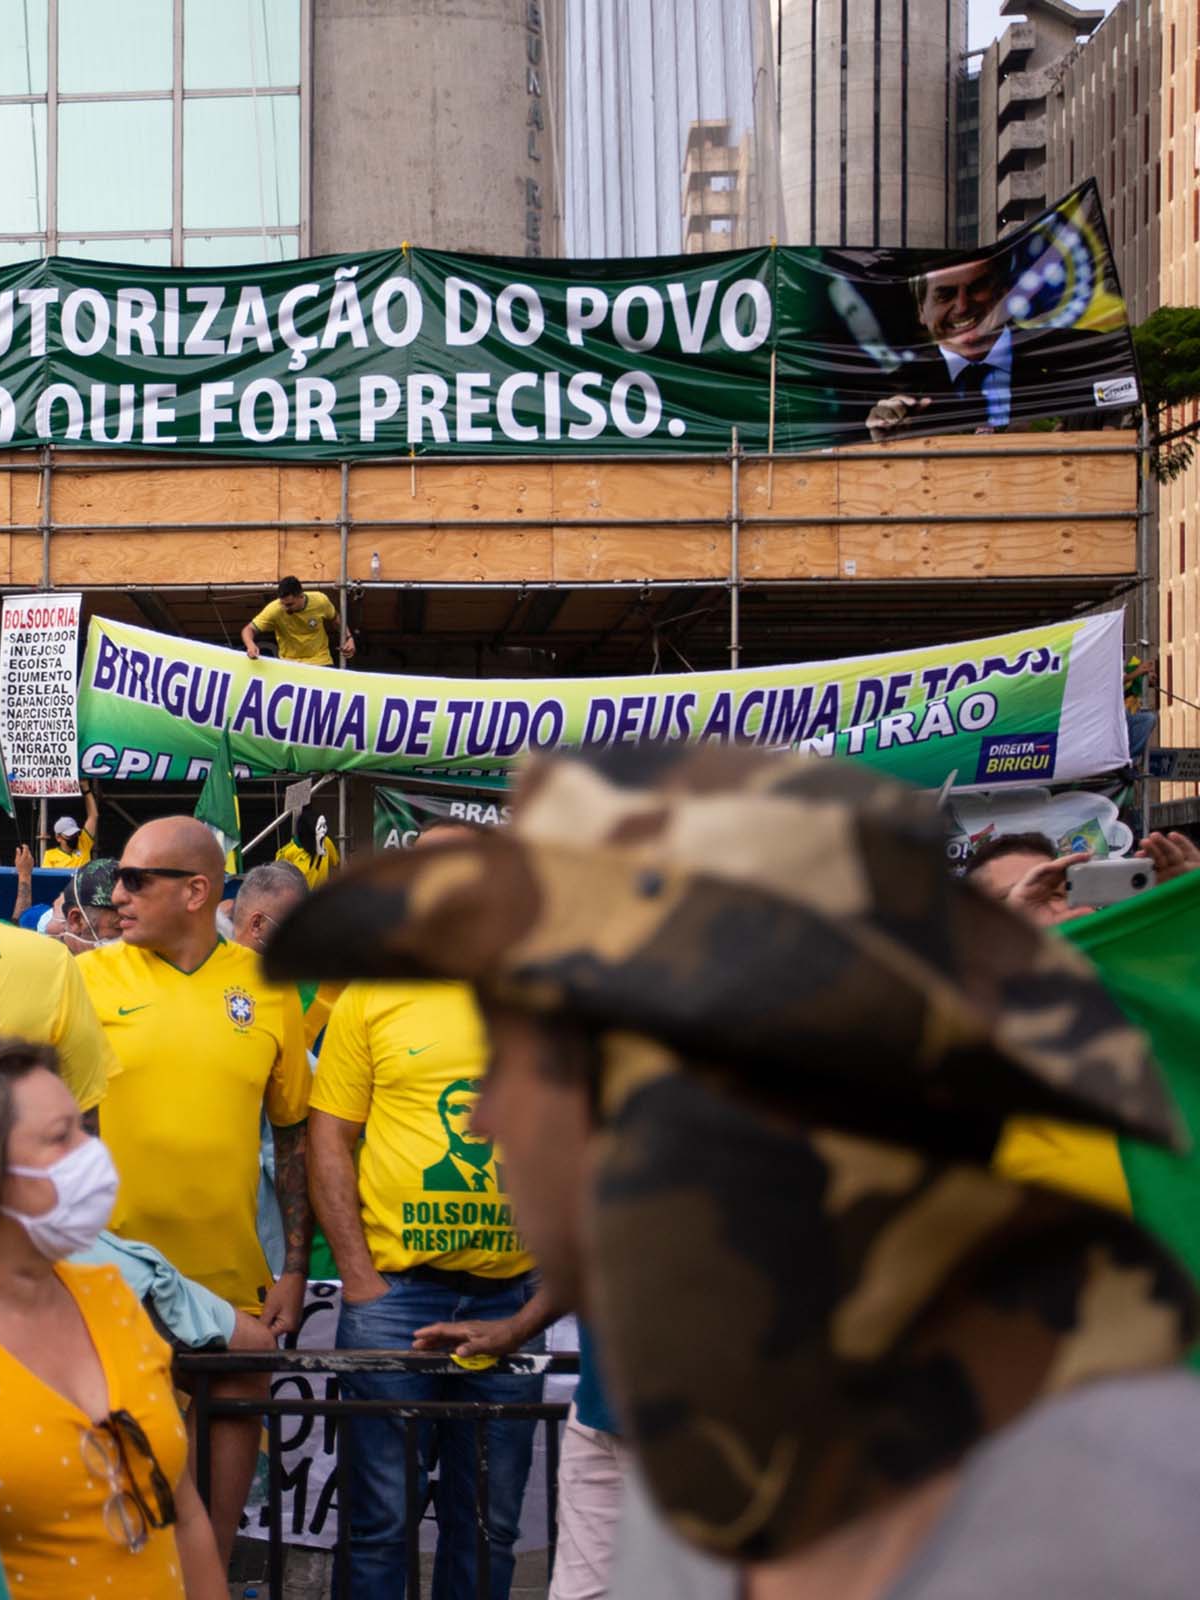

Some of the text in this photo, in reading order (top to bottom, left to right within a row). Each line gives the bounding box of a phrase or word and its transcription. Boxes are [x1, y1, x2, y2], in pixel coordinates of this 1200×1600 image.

[445, 275, 545, 347] DO
[566, 278, 773, 354] POVO
[199, 378, 338, 444] FOR
[359, 370, 687, 444] PRECISO.
[9, 630, 76, 644] SABOTADOR
[10, 644, 66, 657] INVEJOSO
[7, 670, 72, 683] CIUMENTO
[7, 683, 69, 696] DESLEAL
[93, 631, 232, 729] BIRIGUI
[232, 677, 367, 752] ACIMA
[375, 697, 436, 756] DE
[444, 699, 564, 756] TUDO
[581, 693, 697, 750] DEUS
[700, 683, 840, 747] ACIMA
[849, 673, 912, 727] DE
[7, 695, 74, 708] GANANCIOSO
[6, 707, 73, 719] NARCISISTA
[7, 719, 75, 731] OPORTUNISTA
[797, 691, 998, 758] NTRÃO
[11, 743, 68, 755] INGRATO
[989, 741, 1036, 757] DIREITA
[11, 754, 72, 767] MITOMANO
[80, 743, 173, 781] CPI
[986, 753, 1050, 775] BIRIGUI
[12, 767, 72, 779] PSICOPATA
[450, 802, 514, 825] BRAS
[402, 1201, 514, 1226] BOLSONA
